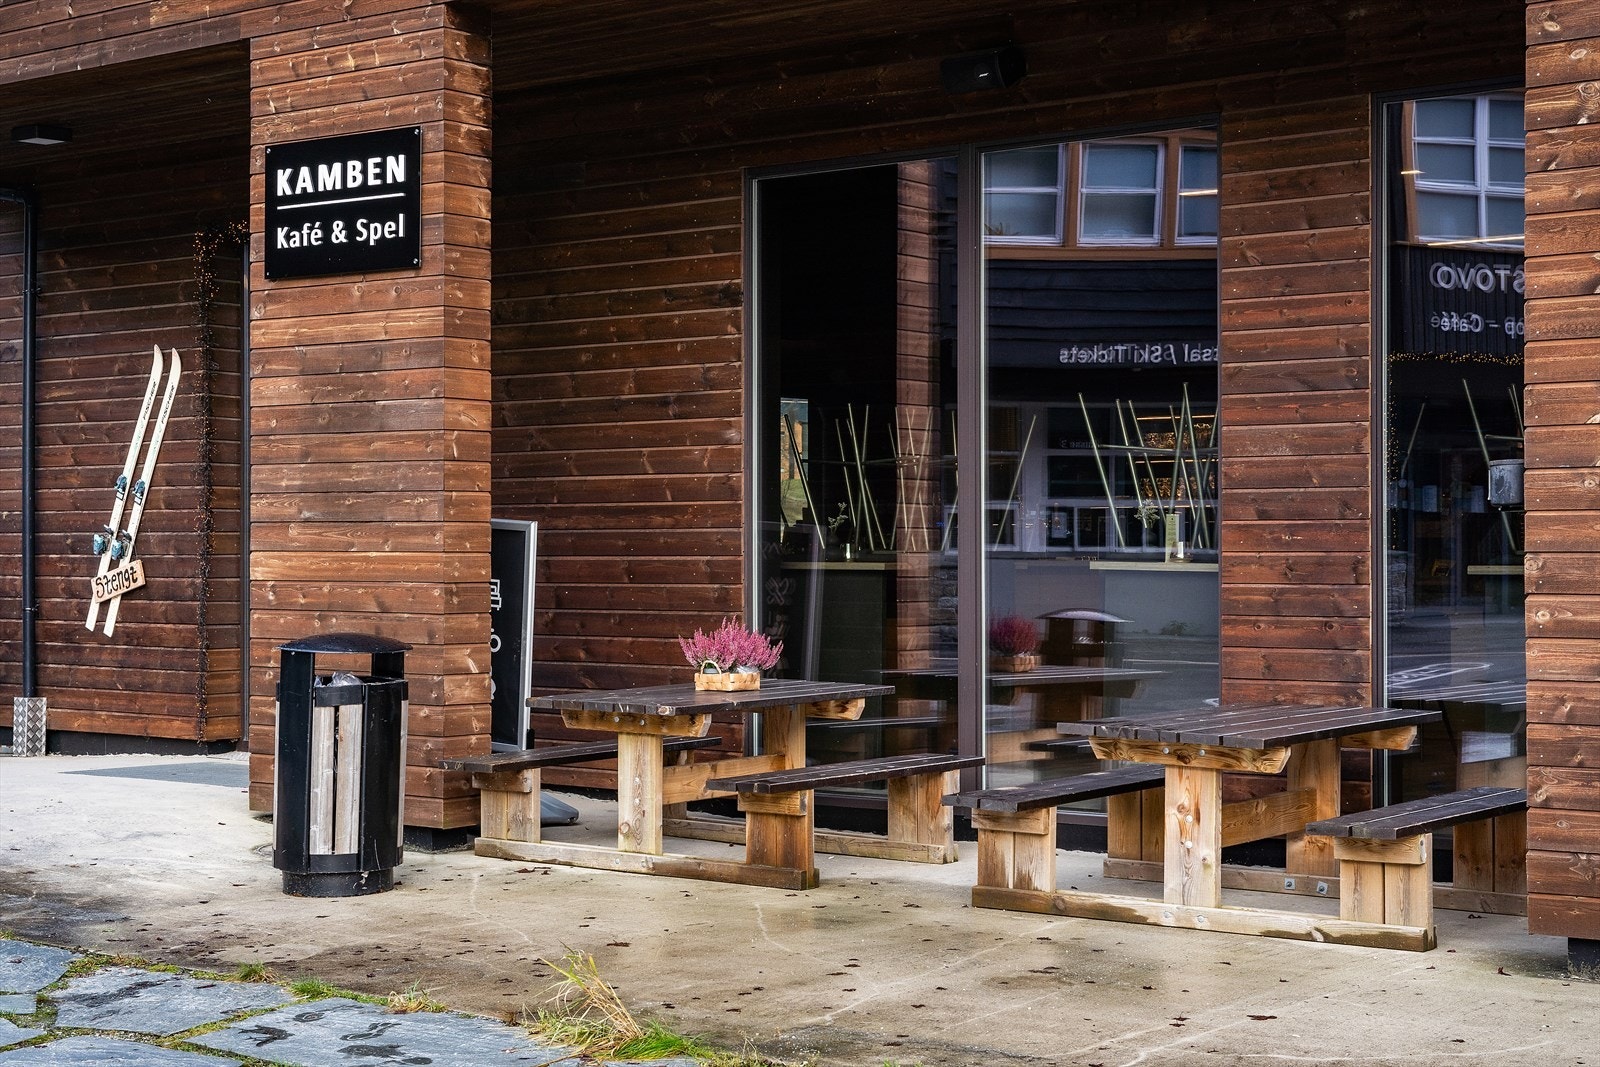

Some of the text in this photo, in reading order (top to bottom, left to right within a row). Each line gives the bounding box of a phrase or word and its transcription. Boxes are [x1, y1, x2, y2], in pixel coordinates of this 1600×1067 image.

[276, 153, 407, 197] KAMBEN
[276, 213, 406, 249] Kafé & Spel
[95, 566, 138, 598] Stengt
